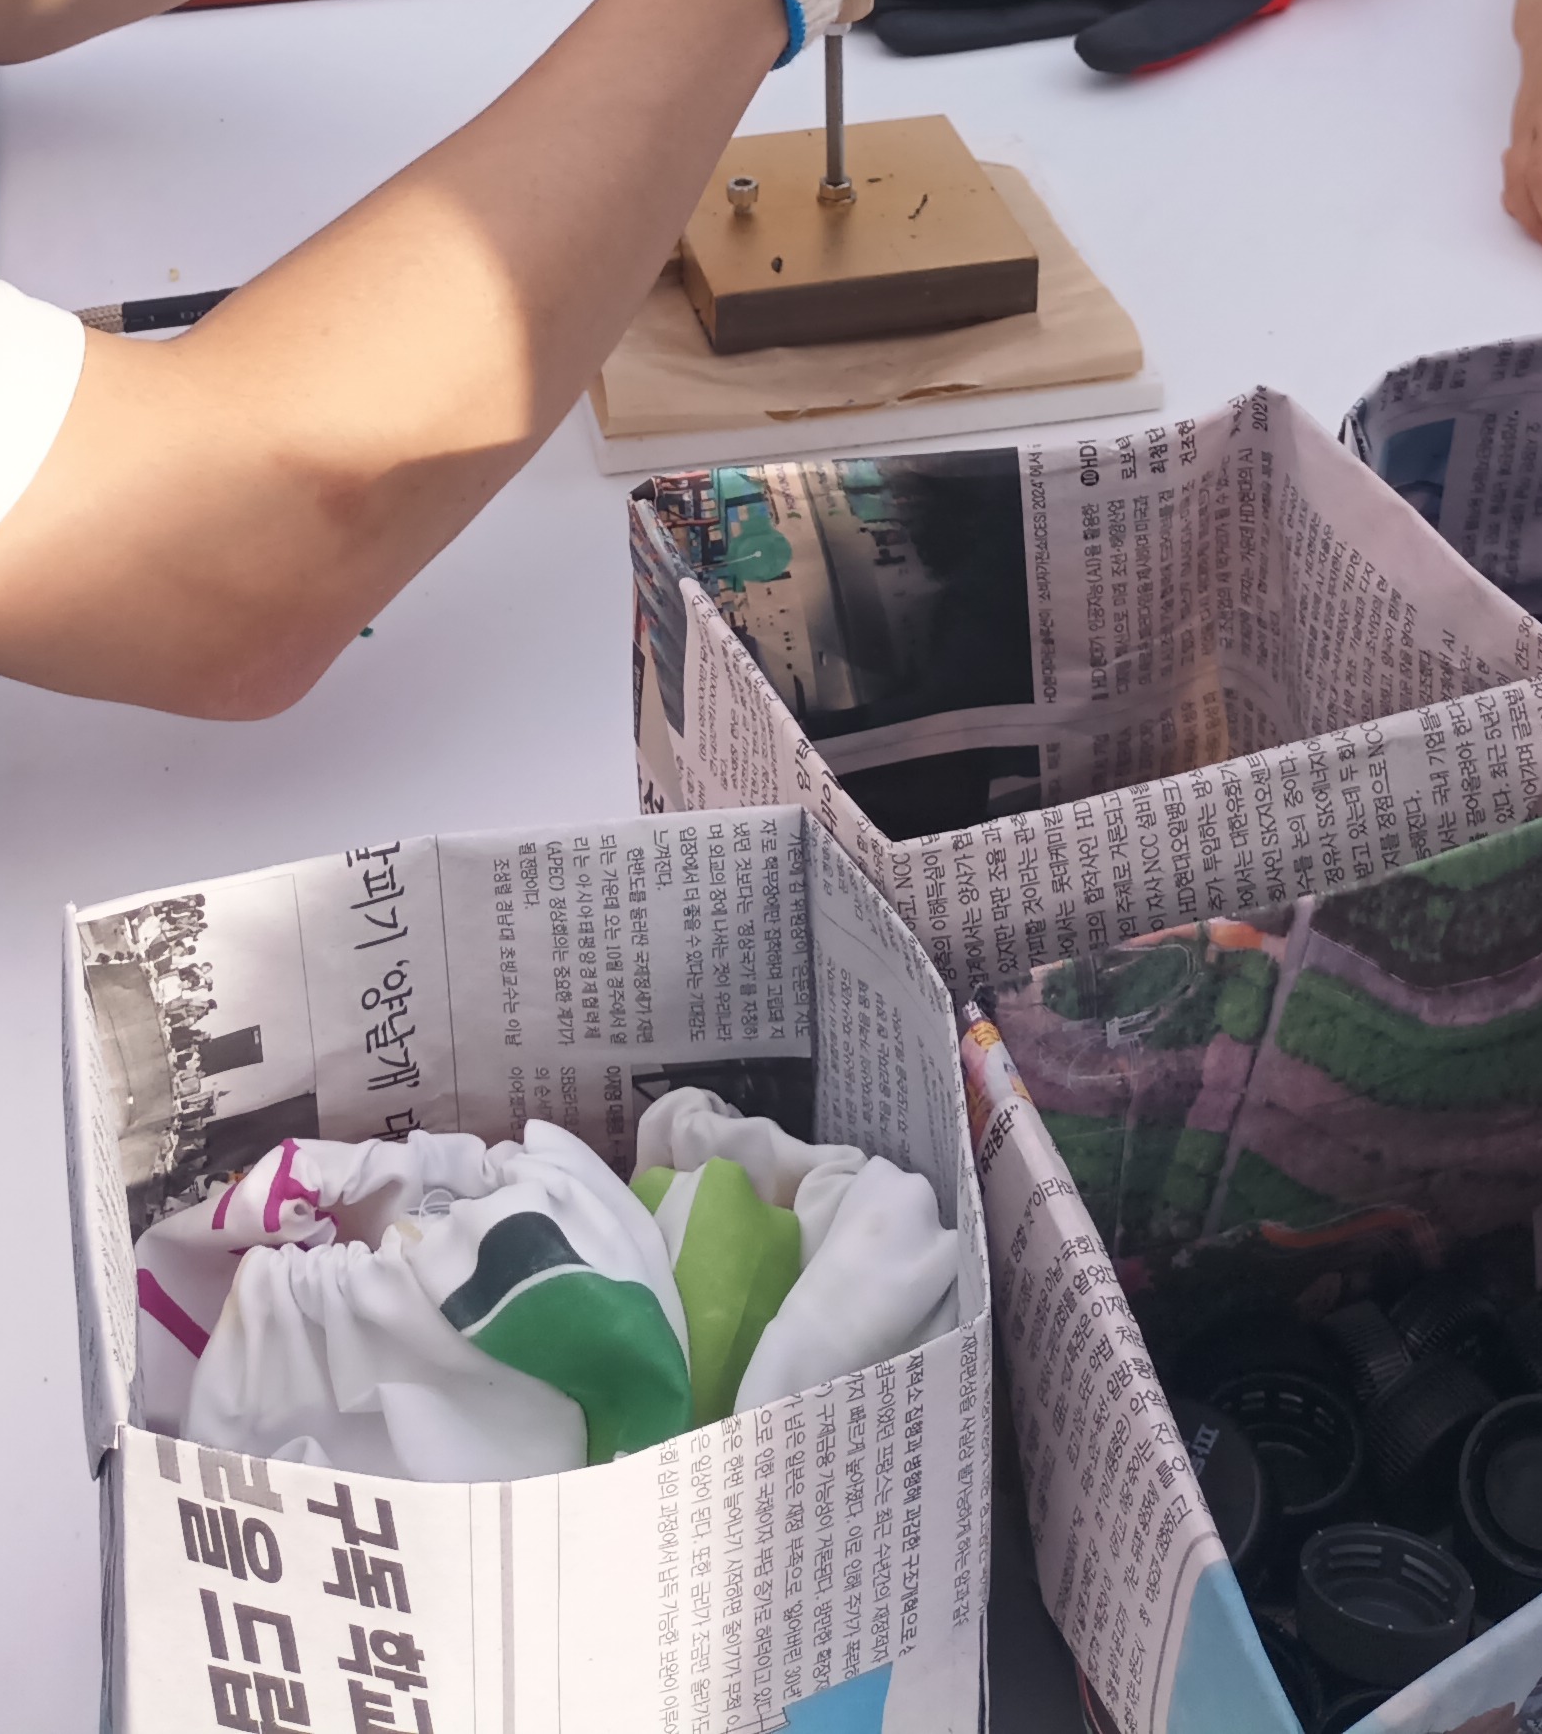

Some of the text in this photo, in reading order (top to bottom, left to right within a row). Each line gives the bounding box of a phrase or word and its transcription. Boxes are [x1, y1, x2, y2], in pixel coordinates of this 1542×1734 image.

[1474, 694, 1509, 780] 최근 5년간
[1278, 750, 1311, 850] 논의 중이다.
[1340, 785, 1369, 840] 있는데
[1368, 761, 1397, 831] 정점으로
[1428, 769, 1452, 807] 국내
[544, 840, 566, 892] (APEC)
[572, 836, 591, 869] 리는
[653, 828, 673, 887] 느껴진다.
[707, 843, 727, 886] 외교의
[732, 821, 752, 853] 냈던
[1070, 796, 1105, 906] 합작사인 HD
[1198, 802, 1228, 912] 추가 투입하는
[1318, 831, 1346, 887] 정유사
[519, 855, 541, 907] 전망이다.
[626, 846, 647, 904] 한반도를
[734, 857, 754, 915] 것보다는
[887, 852, 914, 890] NCC
[920, 848, 950, 932] 이해득실이
[953, 853, 980, 906] 양사가
[986, 847, 1012, 922] 막판 조율
[1017, 847, 1045, 916] 것이라는
[1139, 833, 1166, 912] 자사 NCC
[495, 899, 516, 941] 경남대
[548, 896, 570, 963] 정상회의는
[599, 834, 627, 1028] 되는 가운데 오는 10월 경주에서
[629, 906, 650, 947] 둘러싼
[709, 887, 729, 917] 장에
[678, 826, 707, 1043] 입장에서 더 좋을 수 있다는 기대감도
[711, 918, 730, 960] 나서는
[499, 945, 521, 1014] 초빙교수는
[553, 965, 573, 1004] 중요한
[632, 950, 653, 1015] 국제정세가
[712, 961, 732, 988] 것이
[504, 1018, 523, 1048] 이날
[714, 991, 733, 1043] 우리나라
[657, 1469, 680, 1500] 심의
[813, 1403, 837, 1604] 구제금융 가능성이 거론된다.
[306, 1473, 412, 1615] 구독
[657, 1501, 680, 1565] 과정에서
[753, 1447, 776, 1626] 인한 부담 증가로
[842, 1406, 867, 1639] 빠르게 높아졌다. 이로 인해 주가가
[872, 1444, 895, 1603] 프랑스는 최근 수년간의
[658, 1568, 679, 1599] 납득
[690, 1456, 713, 1675] 일상이 된다. 또한 금리가 조금만
[722, 1453, 745, 1679] 한번 늘어나기 시작하면 줄이기가
[658, 1601, 680, 1646] 가능한
